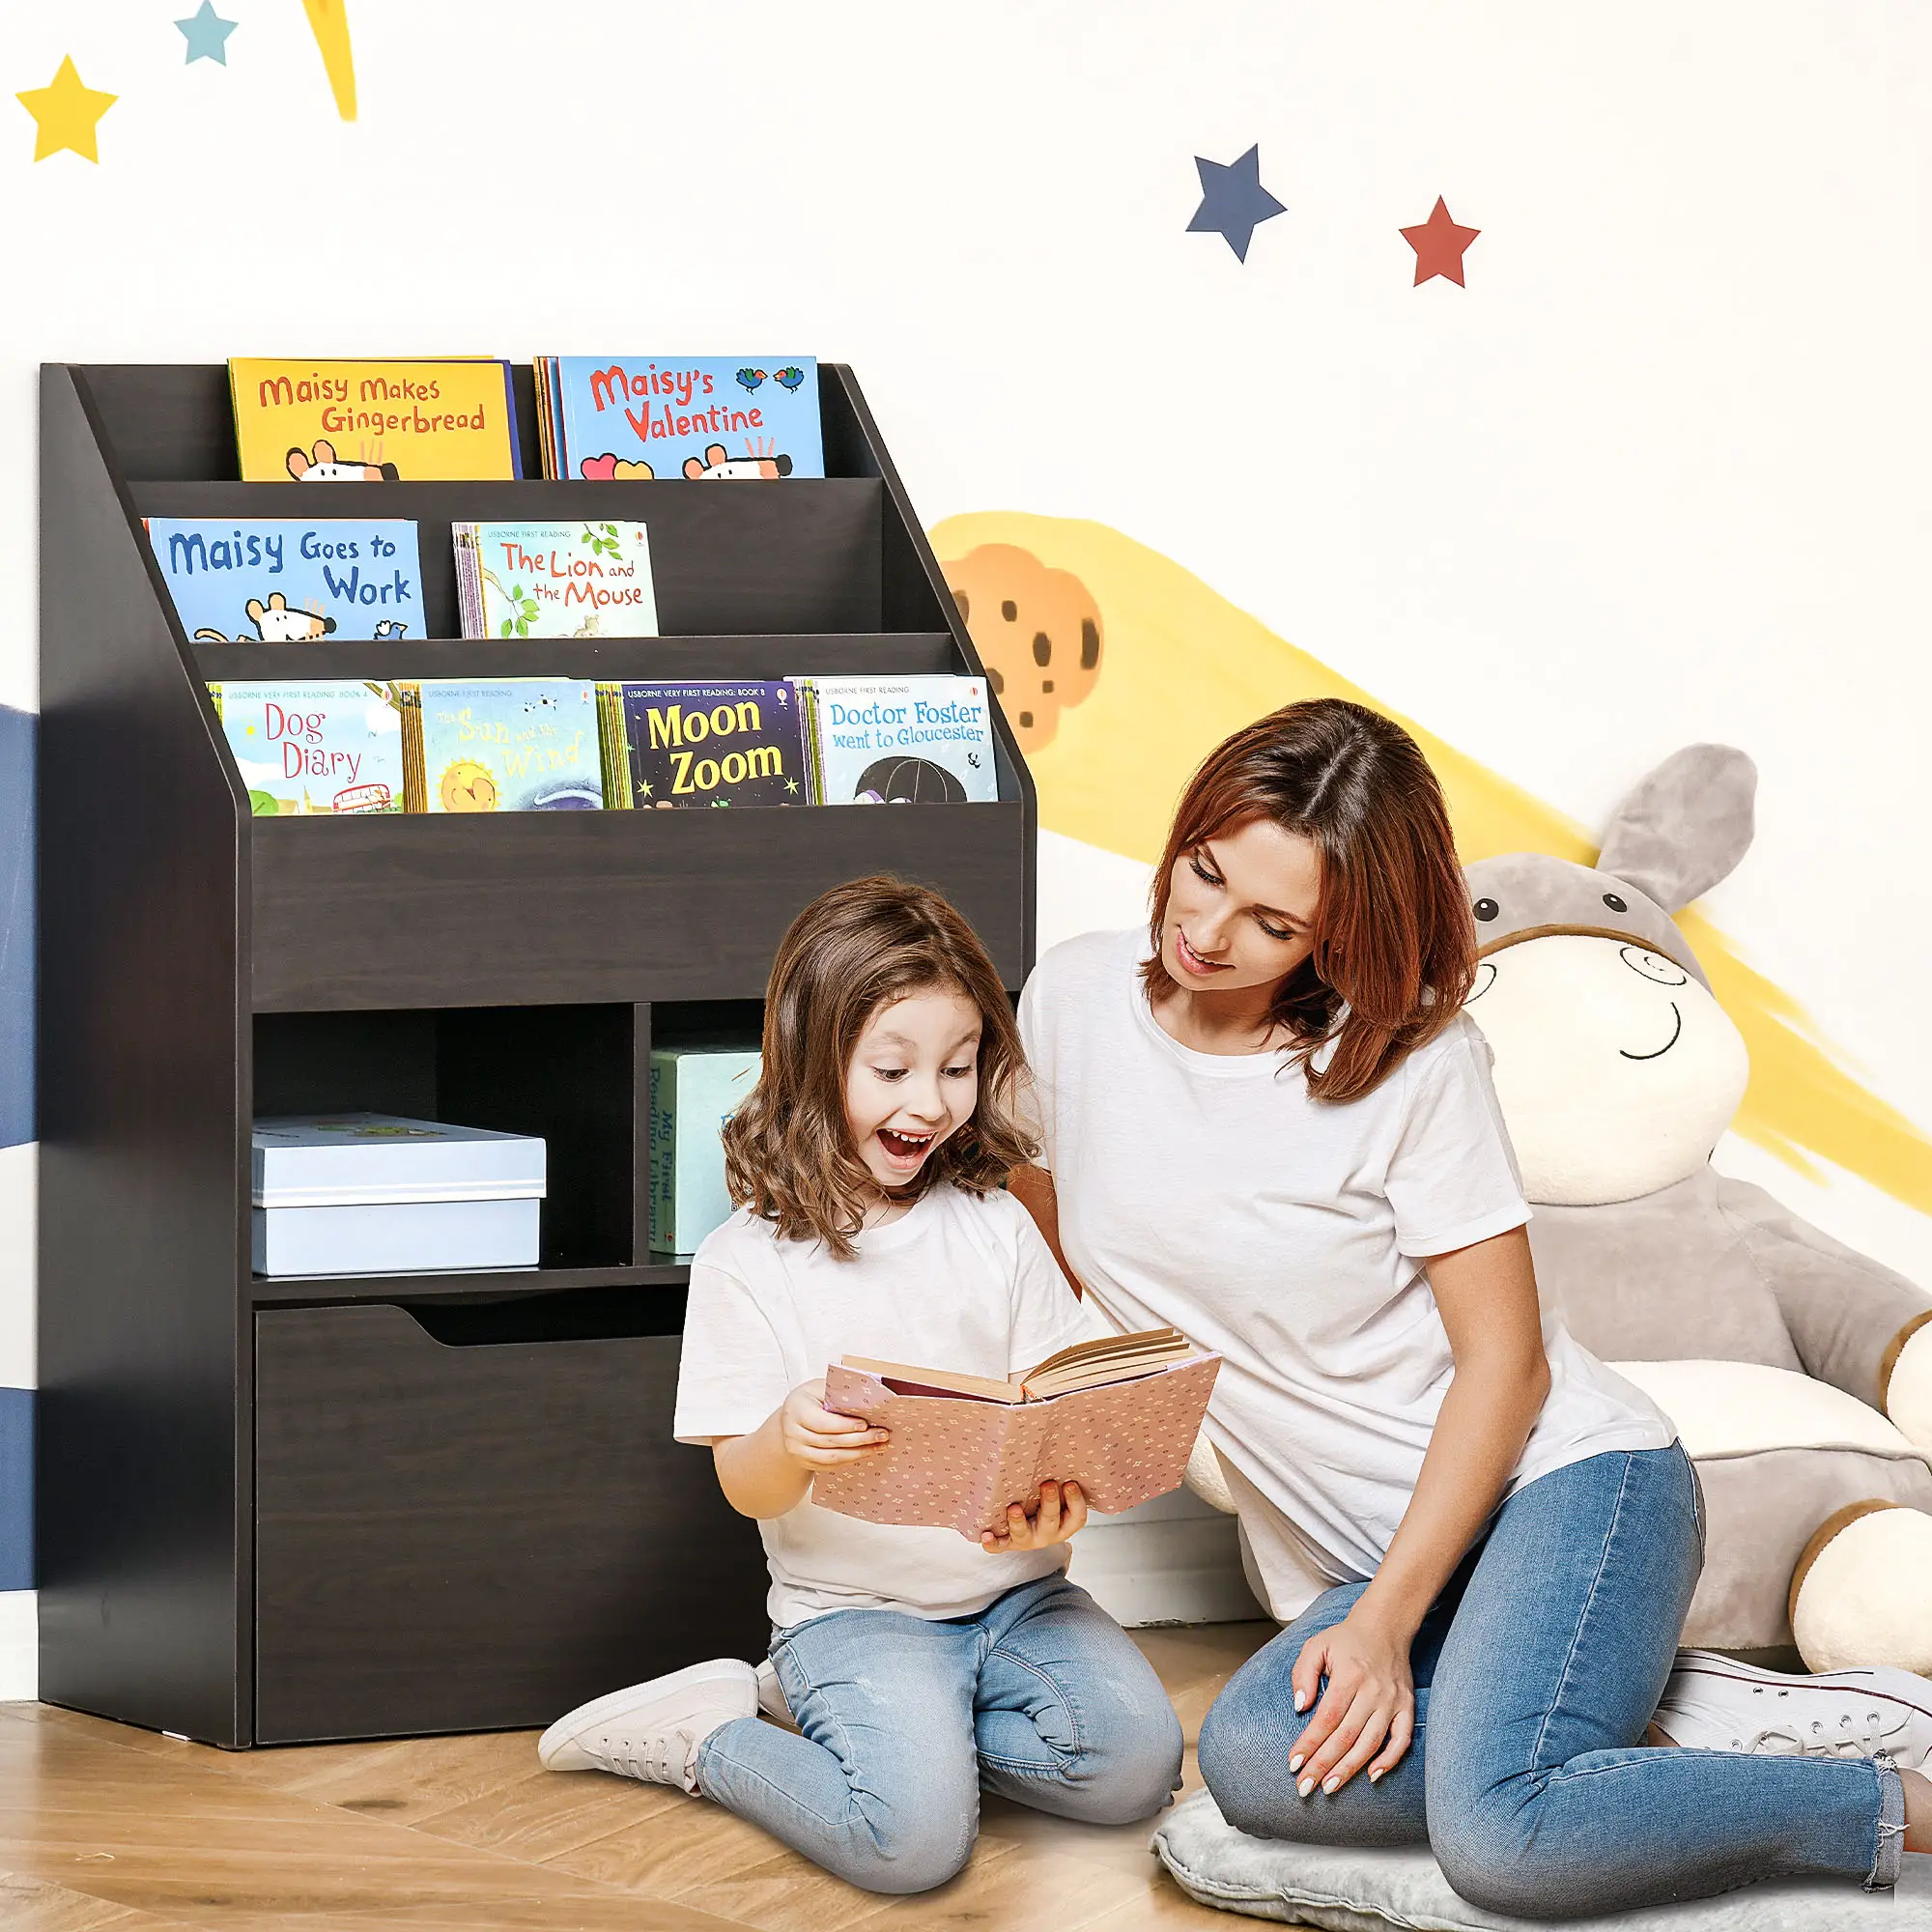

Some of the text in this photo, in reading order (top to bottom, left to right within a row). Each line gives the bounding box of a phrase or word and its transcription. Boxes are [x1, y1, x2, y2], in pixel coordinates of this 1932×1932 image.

[260, 373, 440, 407] Maisy Makes
[590, 364, 713, 412] Maisy's
[322, 404, 485, 435] Gingerbread
[625, 401, 763, 442] Valentine
[169, 530, 396, 575] Maisy Goes to
[500, 543, 635, 578] The Lion and
[323, 564, 412, 605] Work
[533, 582, 643, 610] the Mouse
[229, 691, 261, 699] USBORNE
[628, 690, 661, 698] USBORNE
[831, 700, 981, 725] Doctor Foster
[266, 703, 326, 744] Dog
[458, 708, 510, 744] Sun
[645, 700, 762, 750] Moon
[833, 726, 984, 749] went to Gloucester
[283, 742, 361, 783] Diary
[502, 730, 583, 779] Wind
[669, 745, 783, 795] Zoom
[658, 1110, 672, 1201] My First
